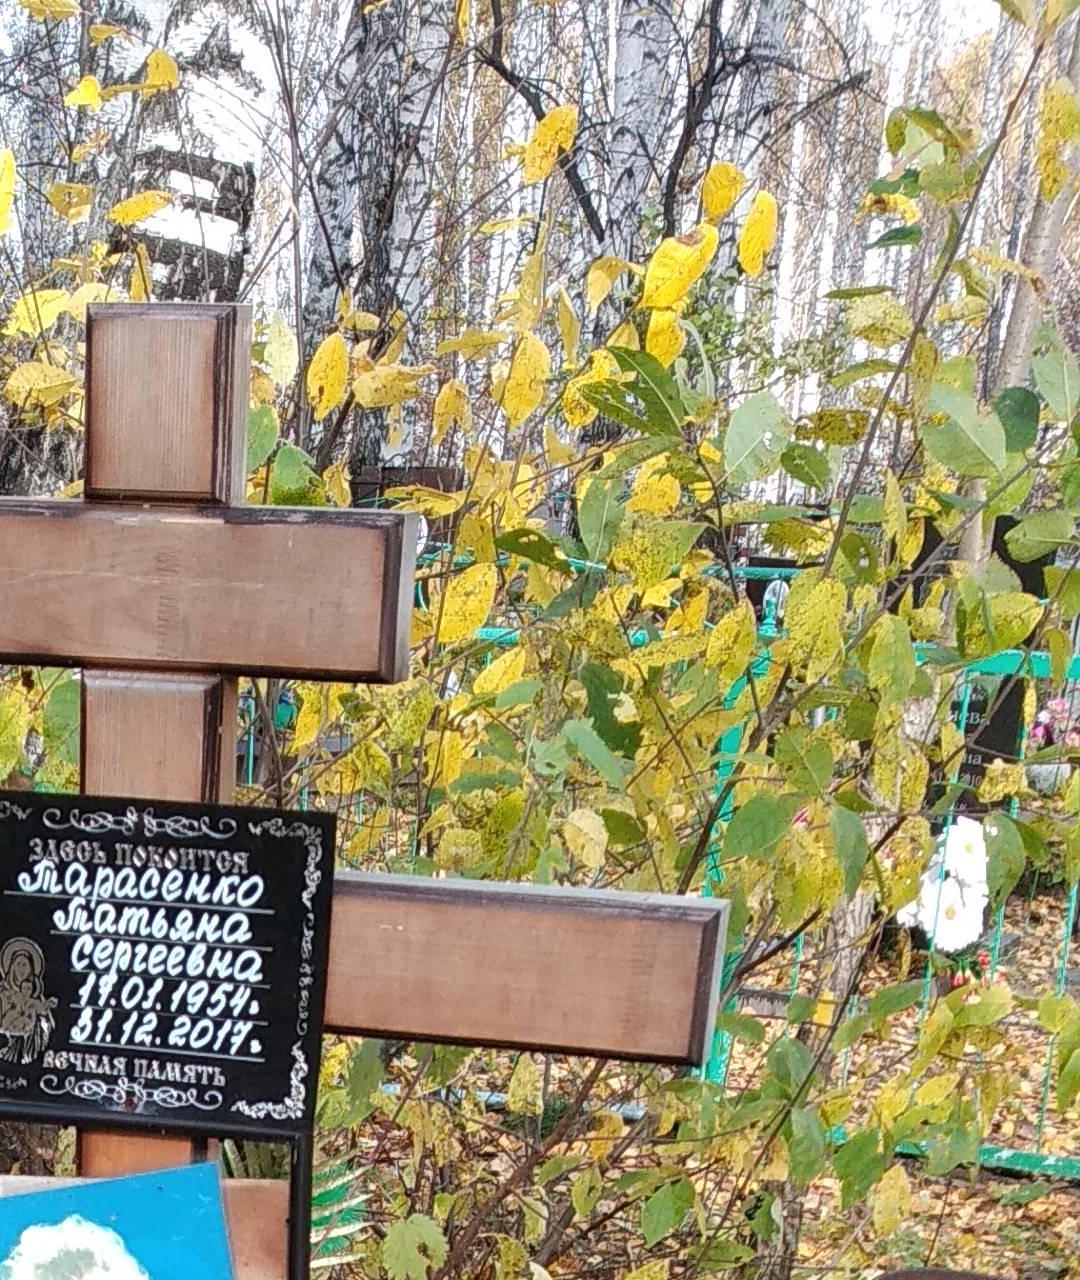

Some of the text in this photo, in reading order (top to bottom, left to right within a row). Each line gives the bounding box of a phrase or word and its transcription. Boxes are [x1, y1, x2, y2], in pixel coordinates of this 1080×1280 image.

[28, 838, 249, 874] ЗДЕСЬ ПОКОИТСЯ
[18, 858, 264, 908] Тарасенко
[52, 896, 252, 943] Татьяна
[42, 1049, 226, 1087] ВЕЧНАЯ ПАМЯТЬ
